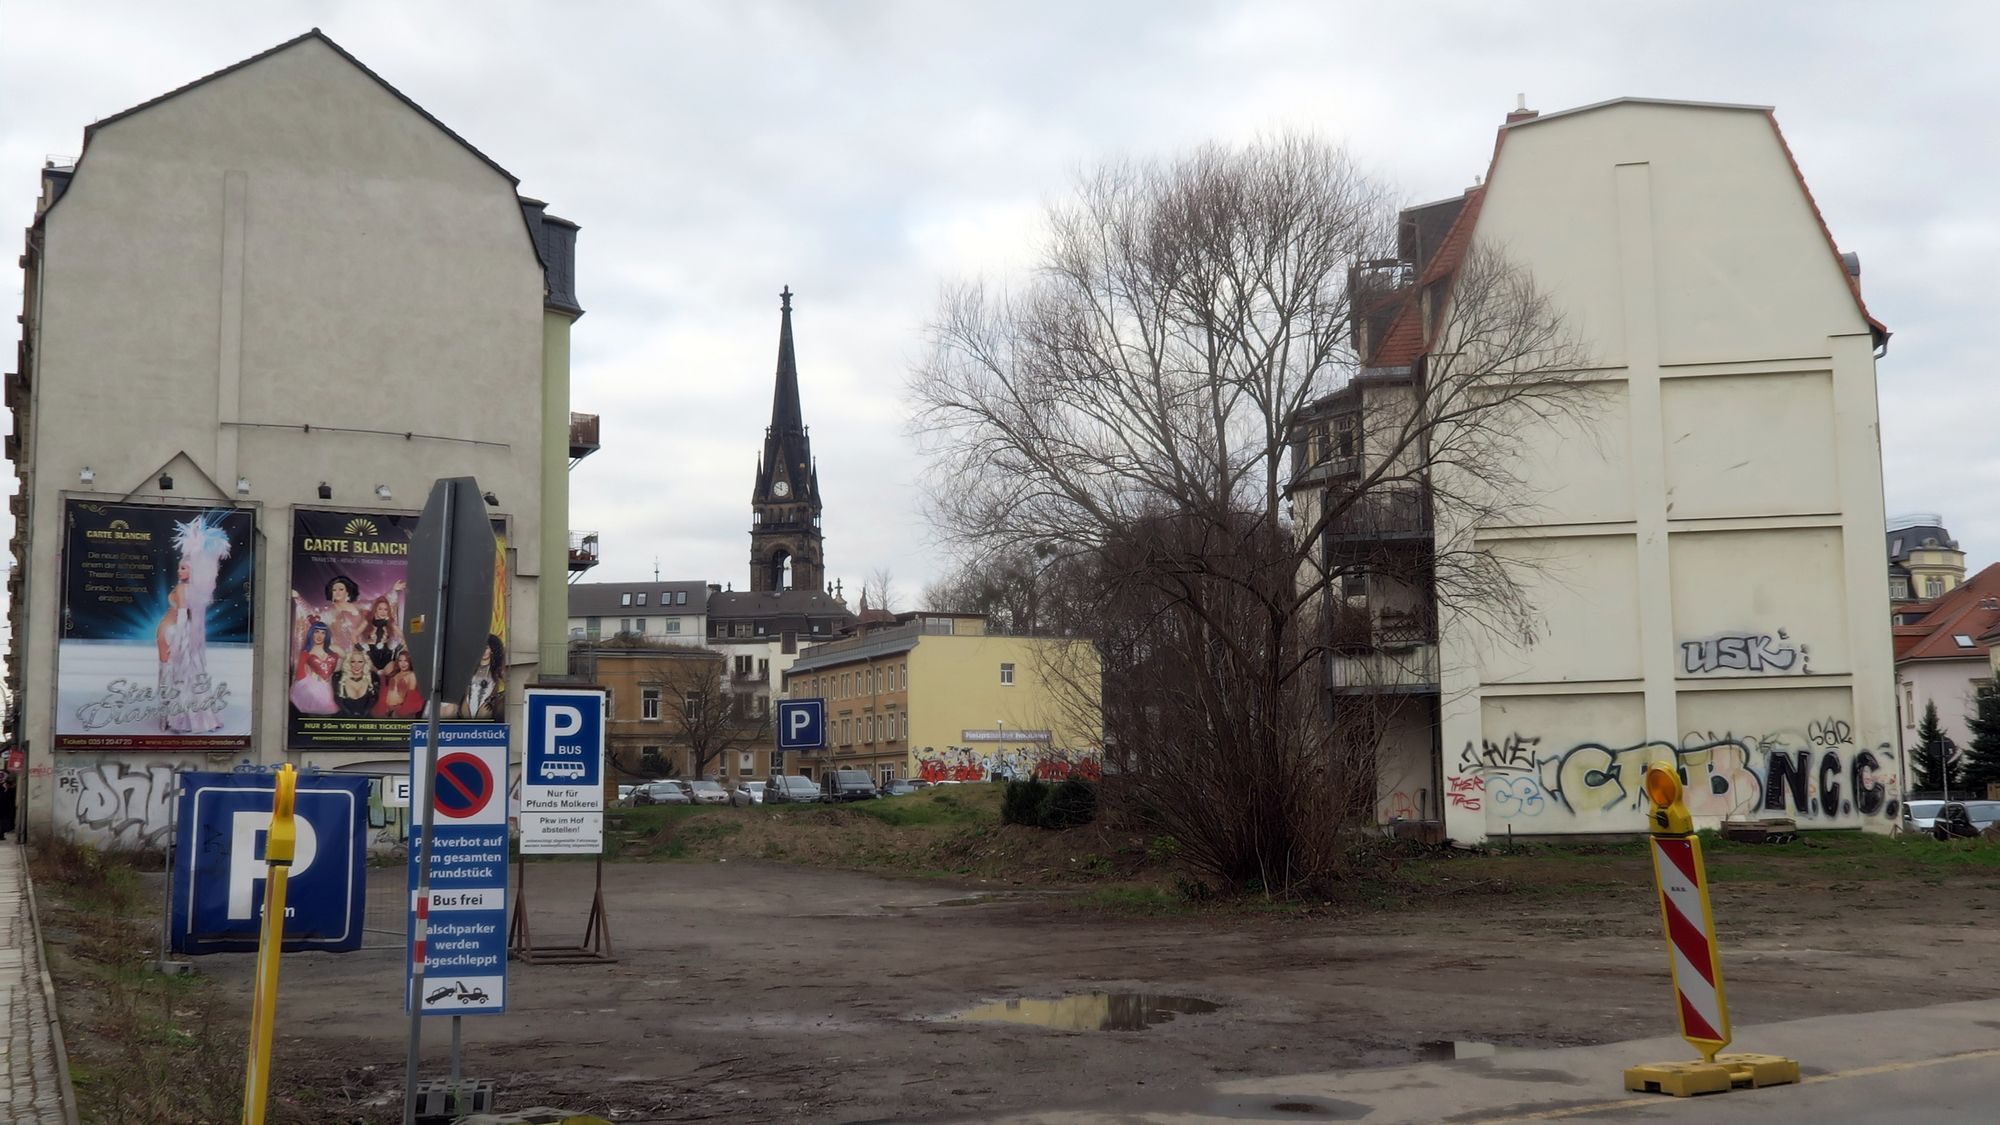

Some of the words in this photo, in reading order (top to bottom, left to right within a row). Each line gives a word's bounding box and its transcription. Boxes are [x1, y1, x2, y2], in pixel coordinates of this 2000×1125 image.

[86, 530, 112, 539] CARTE
[115, 532, 151, 541] BLANCHE
[304, 538, 348, 552] CARTE
[353, 540, 408, 555] BLANCH
[544, 705, 583, 754] P
[791, 710, 810, 739] P
[415, 730, 506, 741] Pritgrundstück
[558, 746, 582, 755] BUS
[566, 789, 578, 797] für
[526, 800, 558, 808] Pfunds
[560, 800, 598, 808] Molkerei
[483, 836, 503, 847] auf
[444, 853, 502, 865] gesamten
[227, 811, 317, 920] P
[429, 867, 493, 878] rundstück
[433, 895, 457, 906] Bus
[460, 894, 483, 905] frei
[426, 924, 496, 937] alschparker
[435, 939, 480, 950] werden
[424, 954, 497, 968] bgeschleppt
